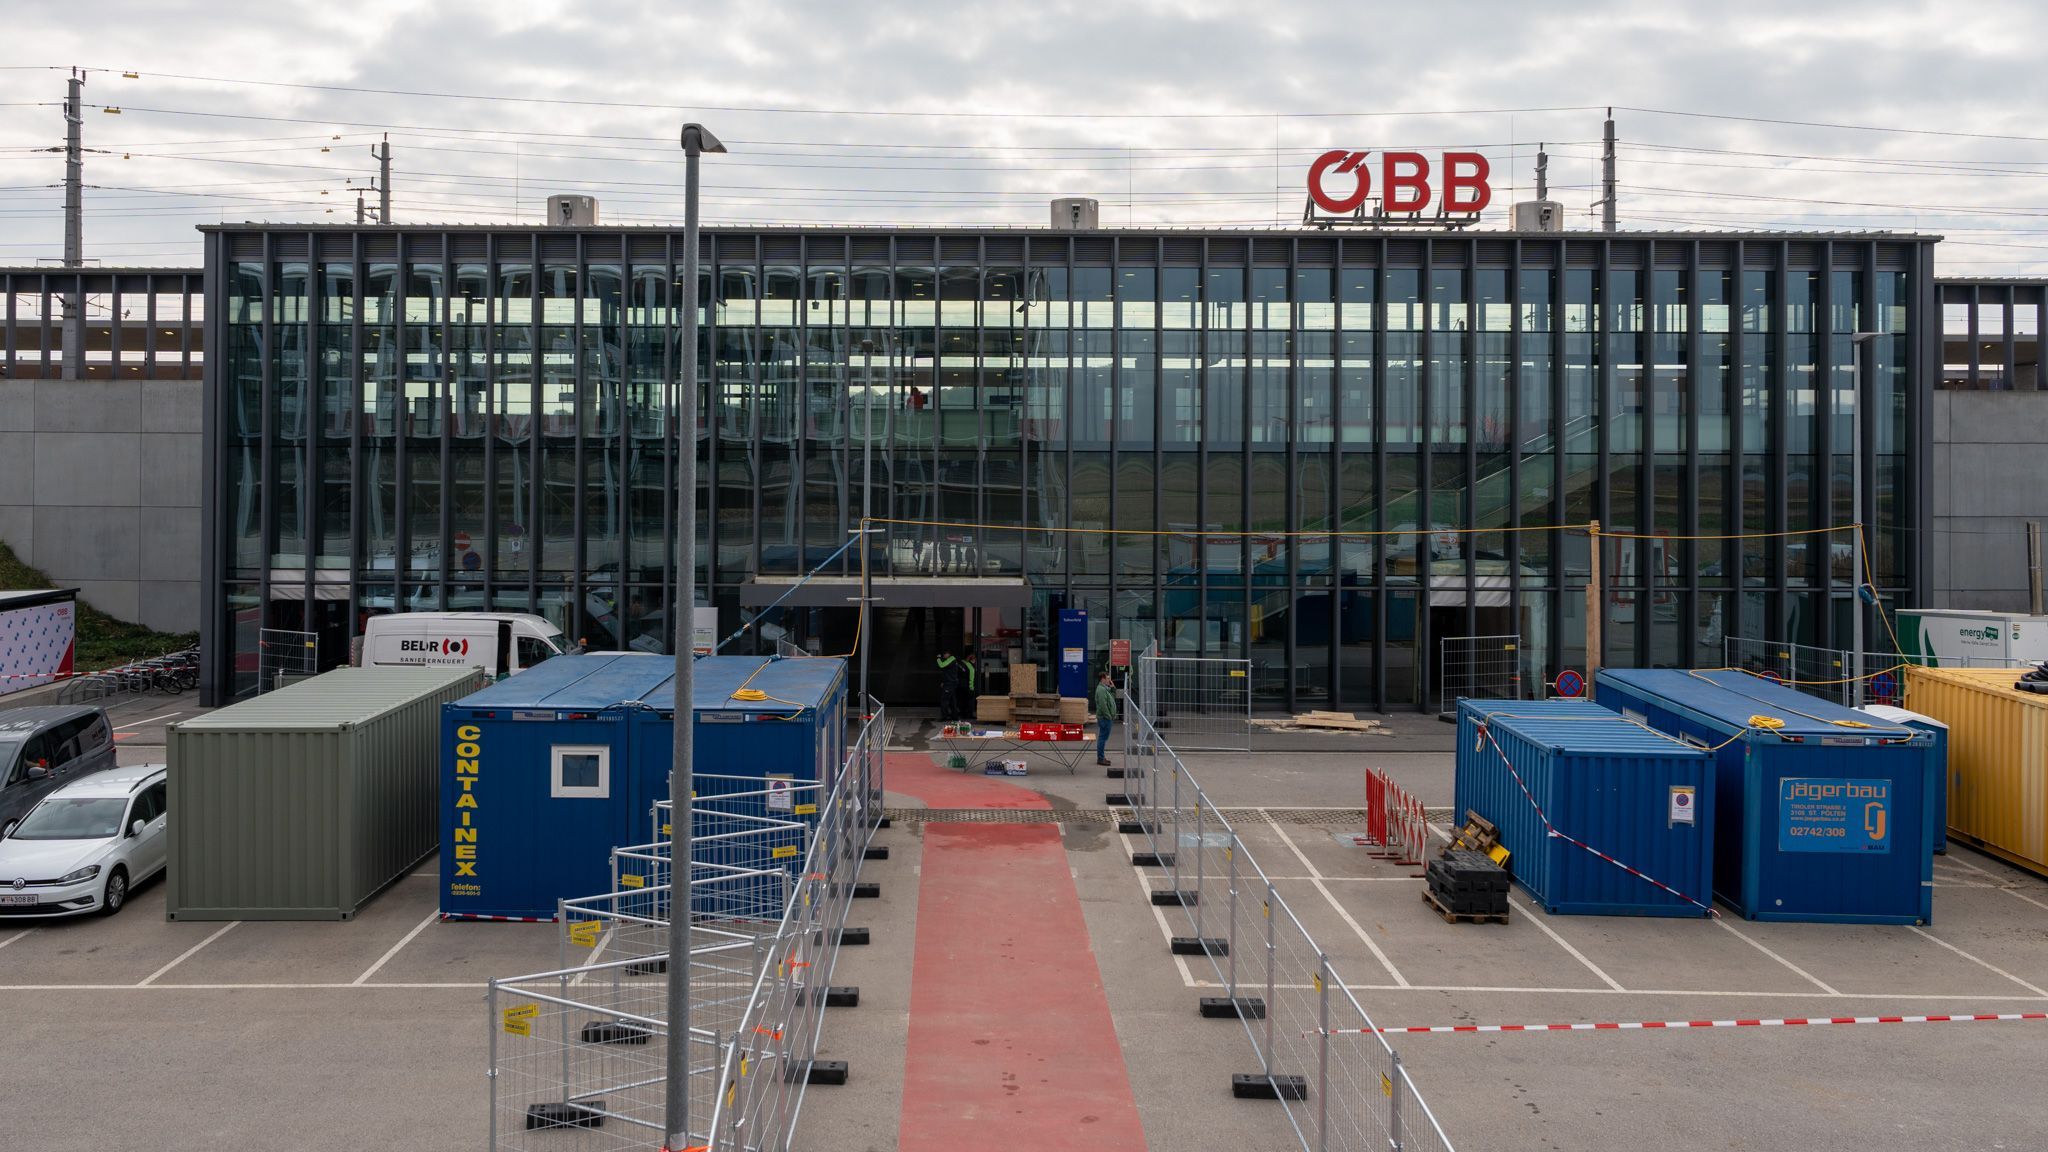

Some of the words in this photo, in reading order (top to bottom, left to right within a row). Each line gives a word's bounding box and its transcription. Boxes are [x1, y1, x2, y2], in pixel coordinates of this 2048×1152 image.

[1307, 150, 1491, 213] ÖBB
[1960, 628, 1985, 640] energy
[455, 725, 481, 876] CONTAINEX
[1785, 782, 1886, 801] jägerbau
[1790, 826, 1846, 837] 02742/308
